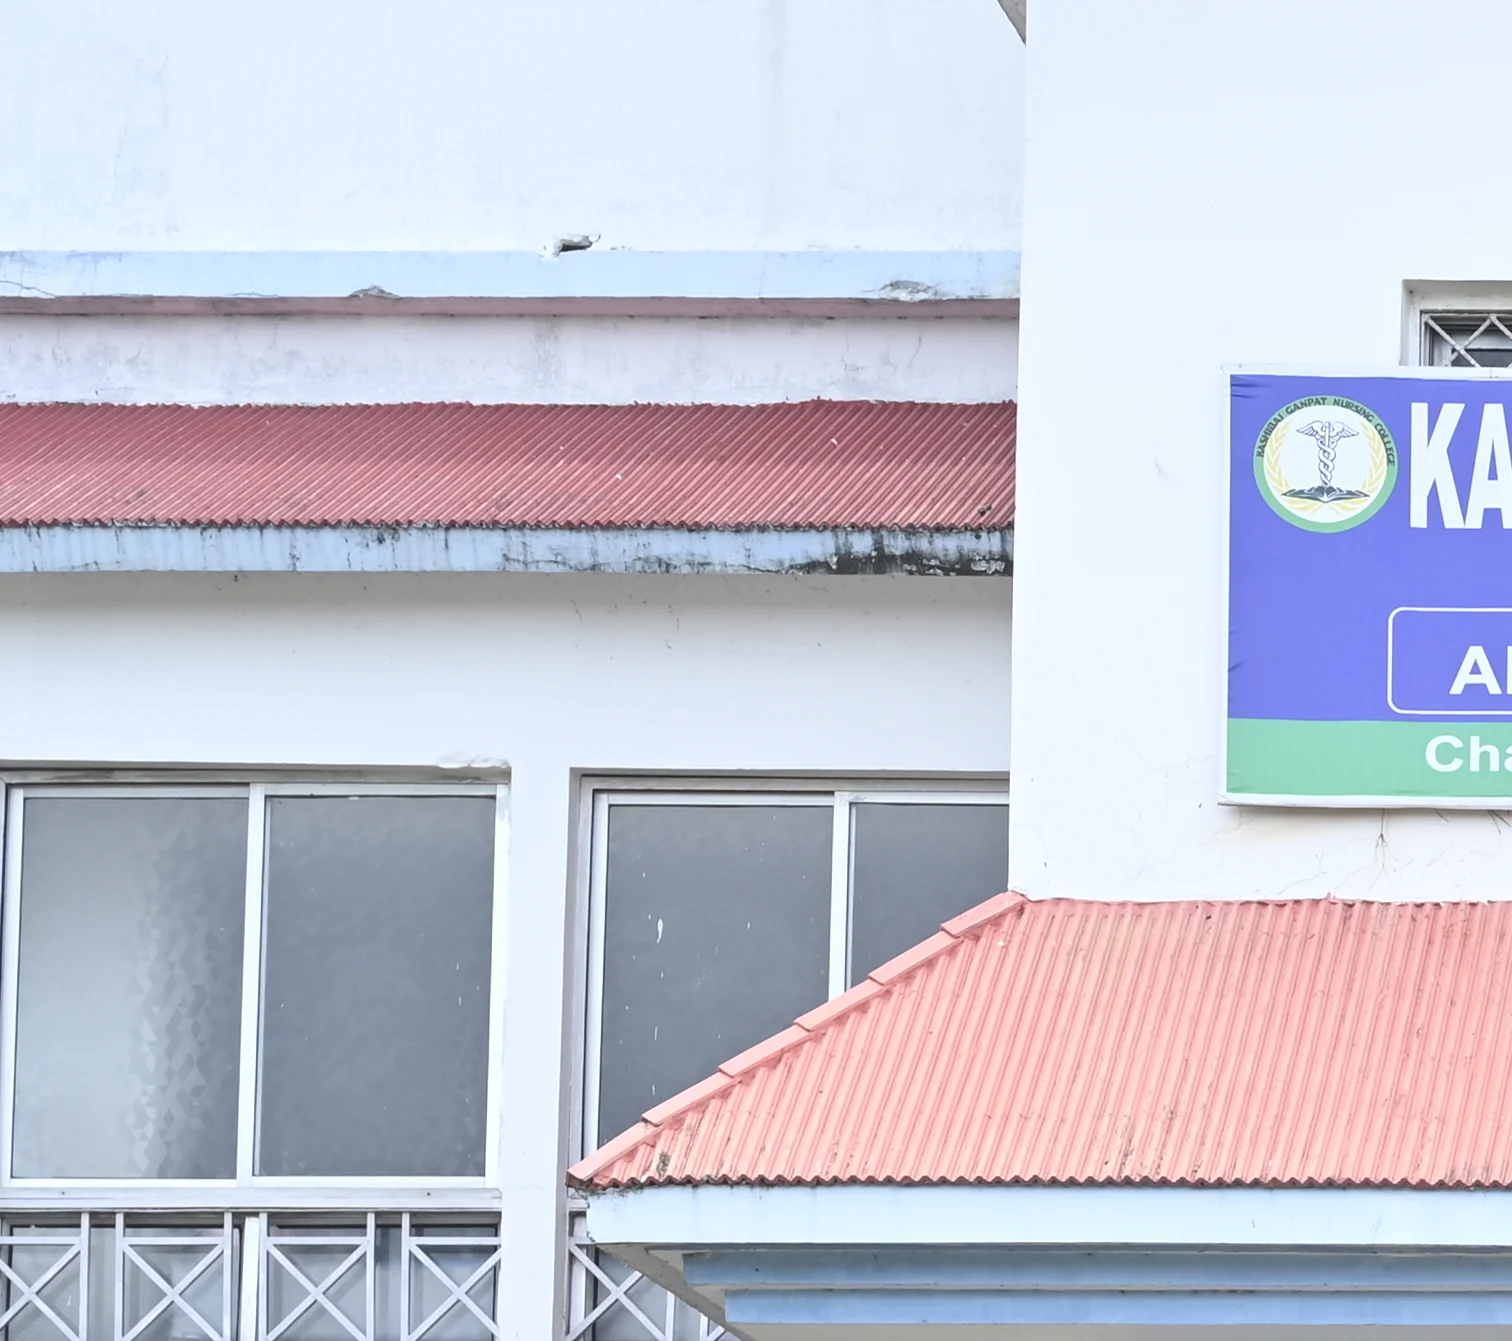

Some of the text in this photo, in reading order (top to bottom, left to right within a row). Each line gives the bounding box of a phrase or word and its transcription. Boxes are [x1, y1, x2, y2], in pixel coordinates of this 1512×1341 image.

[1256, 397, 1395, 467] KASHIBAI GANPAT NURSING COLLEGE
